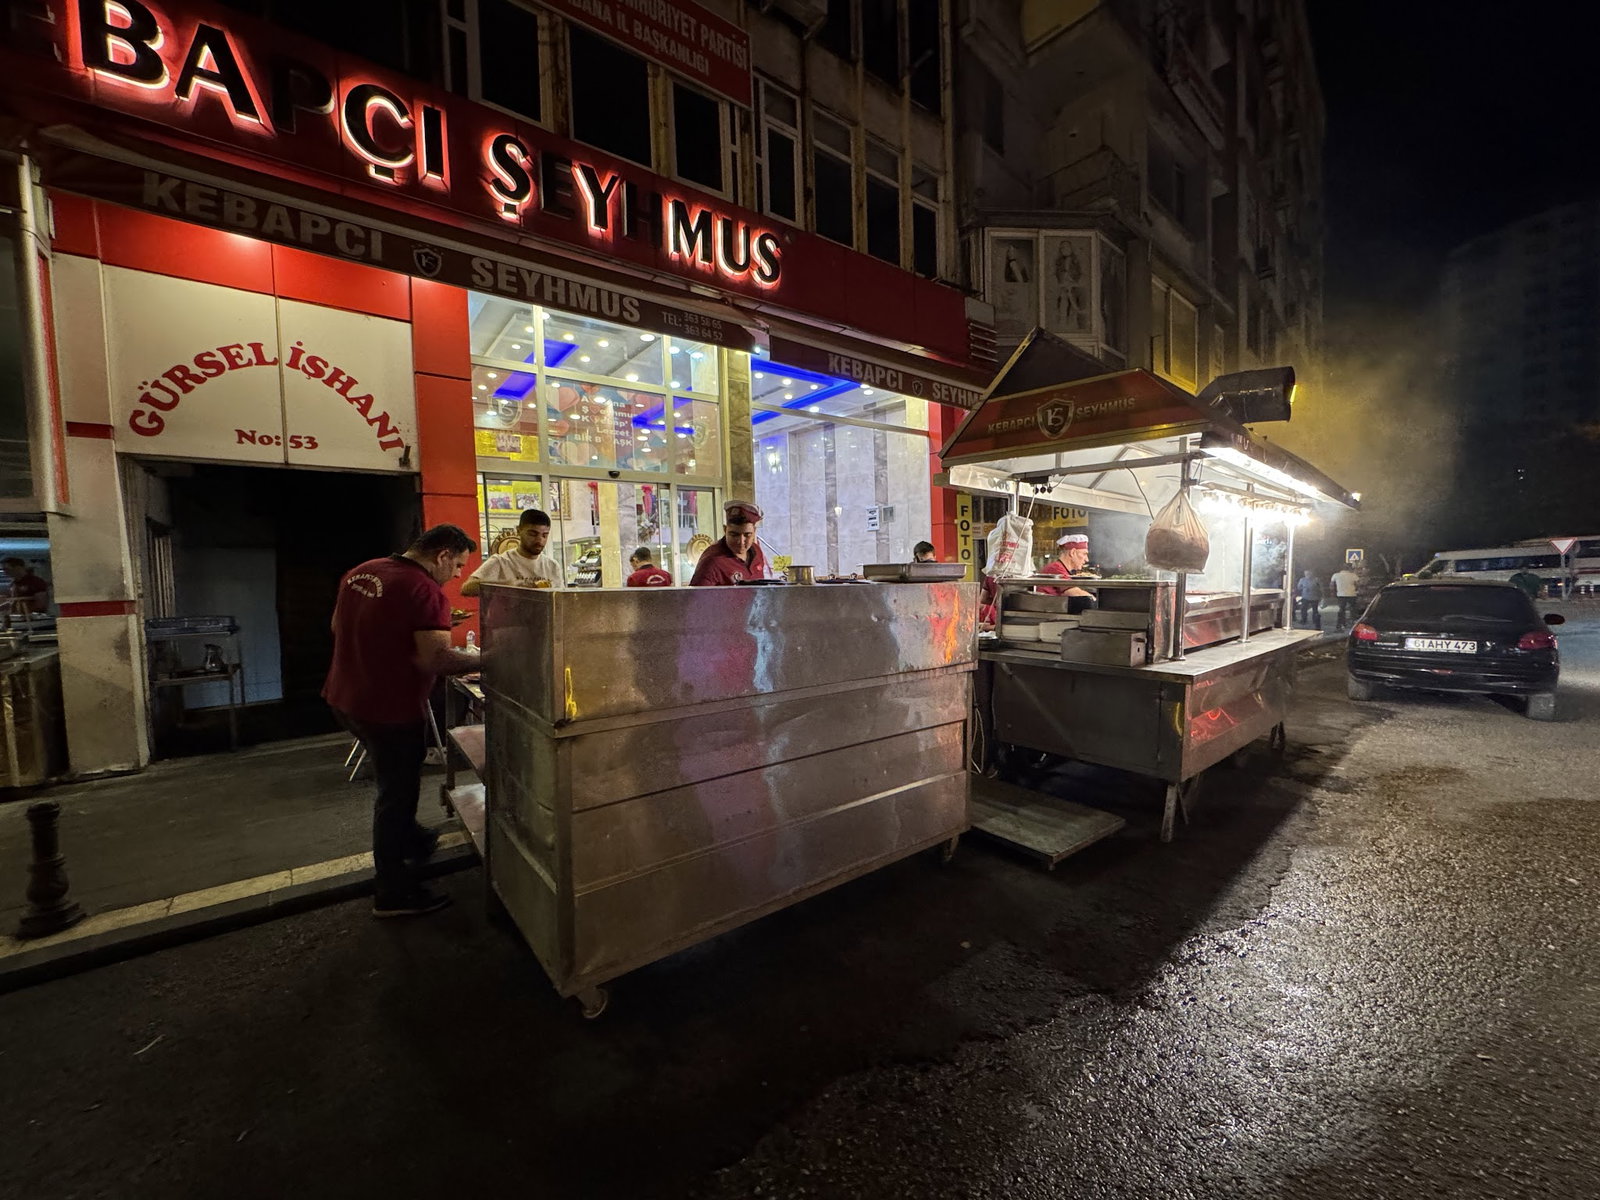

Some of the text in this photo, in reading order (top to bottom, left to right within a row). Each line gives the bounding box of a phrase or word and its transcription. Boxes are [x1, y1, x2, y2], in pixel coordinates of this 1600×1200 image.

[488, 134, 781, 285] ŞEYHMUS
[662, 312, 682, 327] TEL:
[684, 312, 698, 324] 363
[684, 325, 699, 336] 363
[129, 341, 404, 451] GÜRSEL İŞHANI
[234, 429, 319, 450] No: 53
[1053, 505, 1087, 521] FOTO
[959, 505, 972, 561] FOTO
[1427, 639, 1453, 650] AHY
[1453, 640, 1477, 651] 473
